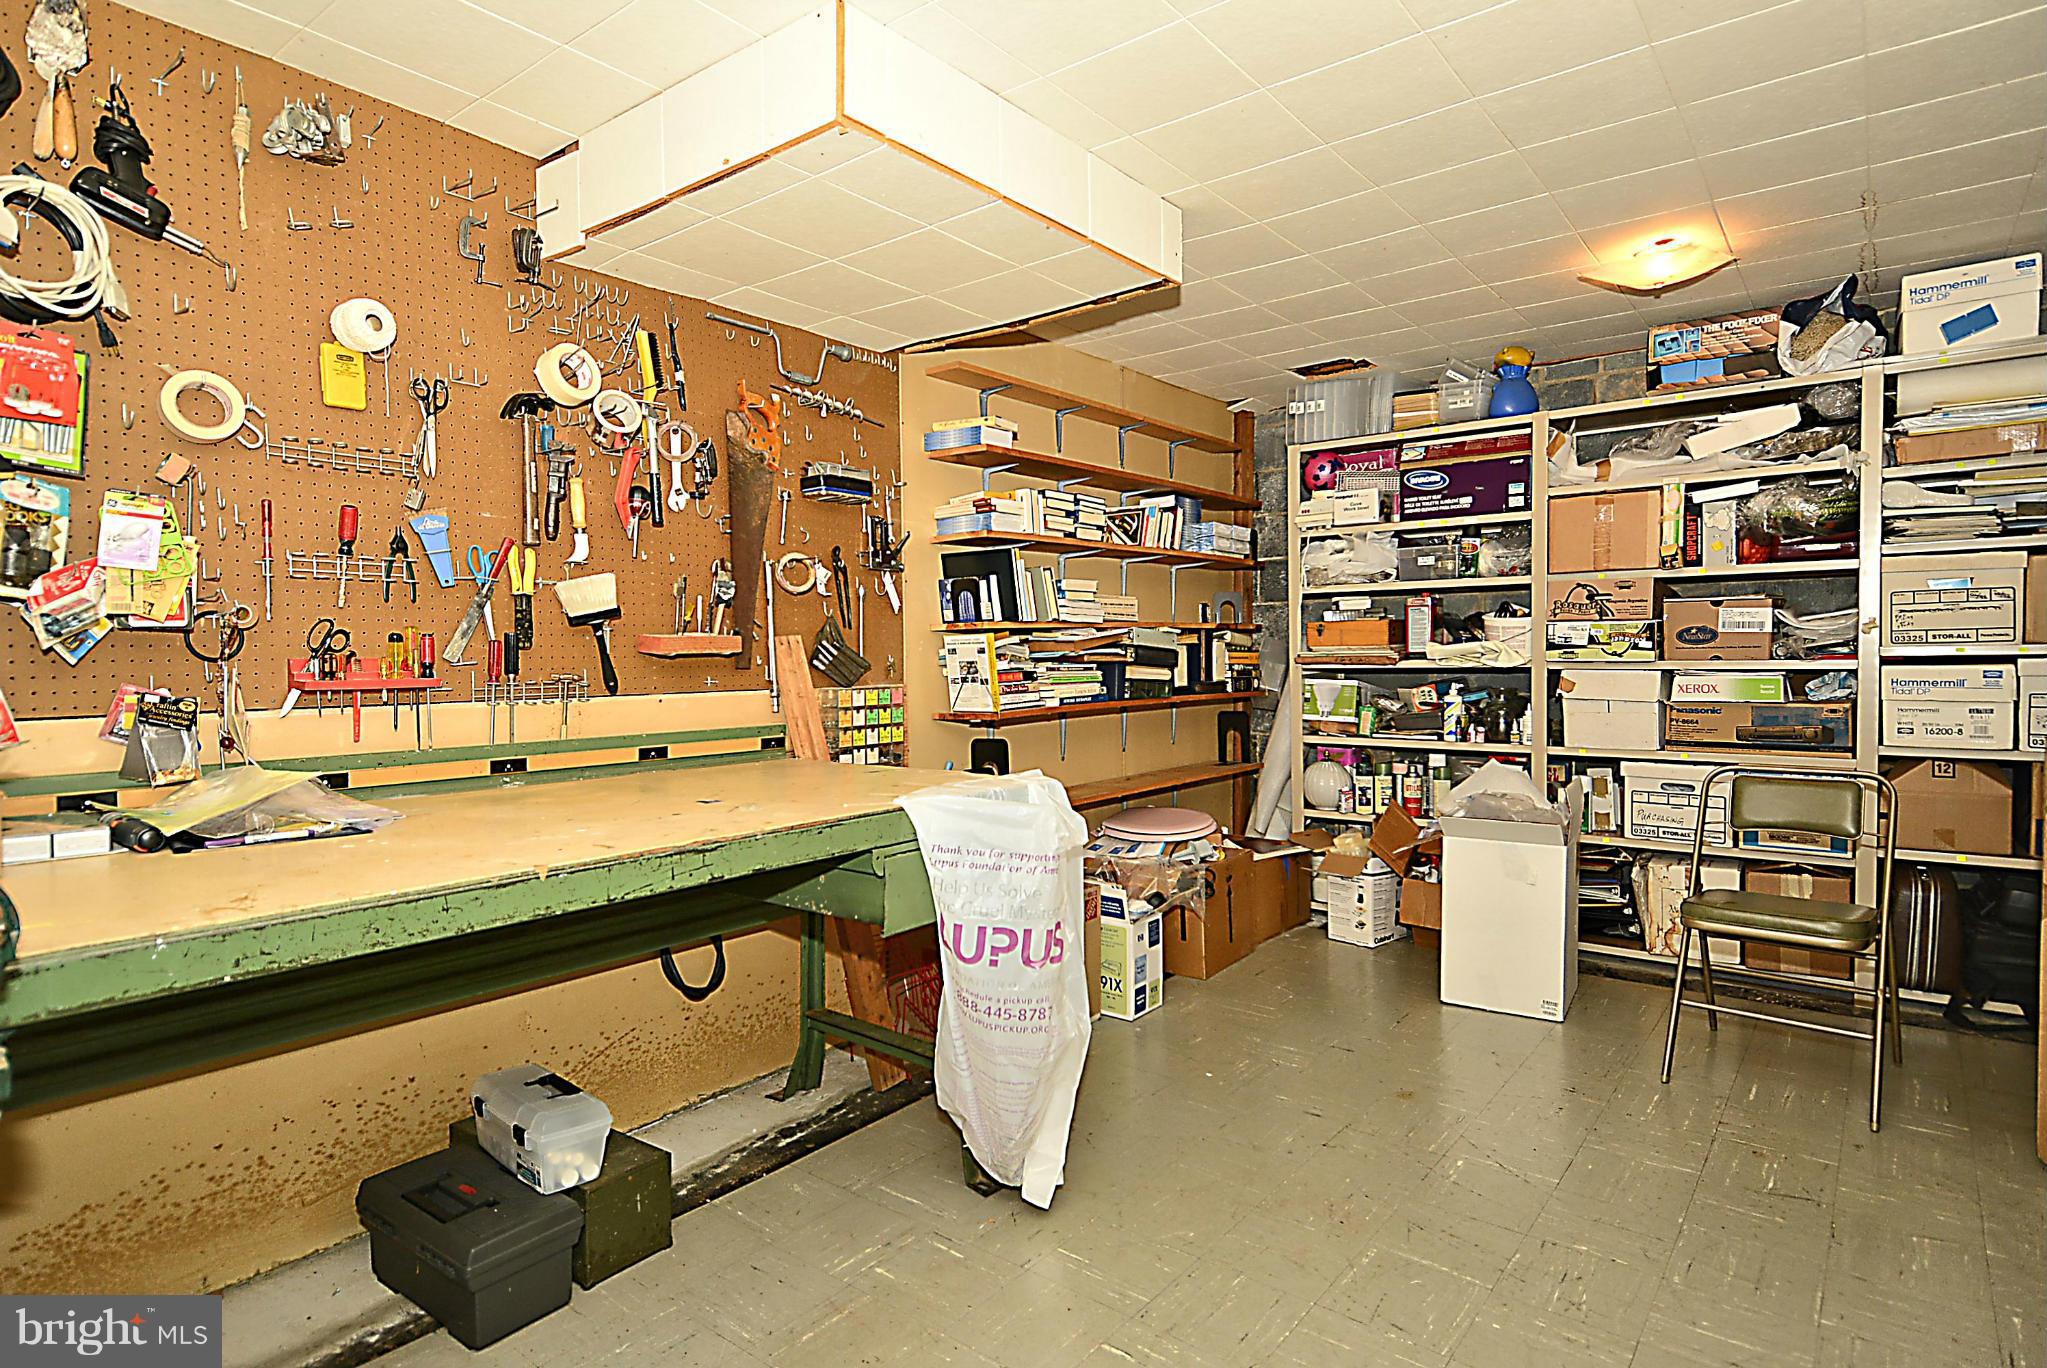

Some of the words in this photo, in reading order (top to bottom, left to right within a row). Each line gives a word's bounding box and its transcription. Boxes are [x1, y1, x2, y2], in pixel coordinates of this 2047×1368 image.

[1909, 275, 1987, 297] Hammermill
[1936, 292, 1950, 301] DP
[1702, 322, 1721, 333] THE
[1722, 318, 1747, 330] FOOT
[1748, 313, 1778, 325] FIXER
[1686, 515, 1697, 561] SHOPCRAFT
[1894, 634, 1924, 642] 03325
[1890, 678, 1966, 688] Hammermill
[1677, 684, 1720, 694] XEROX
[1671, 706, 1722, 715] Panasonic
[1924, 727, 1964, 736] 16200-8
[1936, 762, 1951, 774] 12
[931, 844, 962, 856] Thank
[966, 848, 986, 858] you
[989, 848, 1005, 860] for
[1026, 866, 1037, 875] of
[1100, 975, 1123, 993] 91X
[1003, 995, 1033, 1005] pickup
